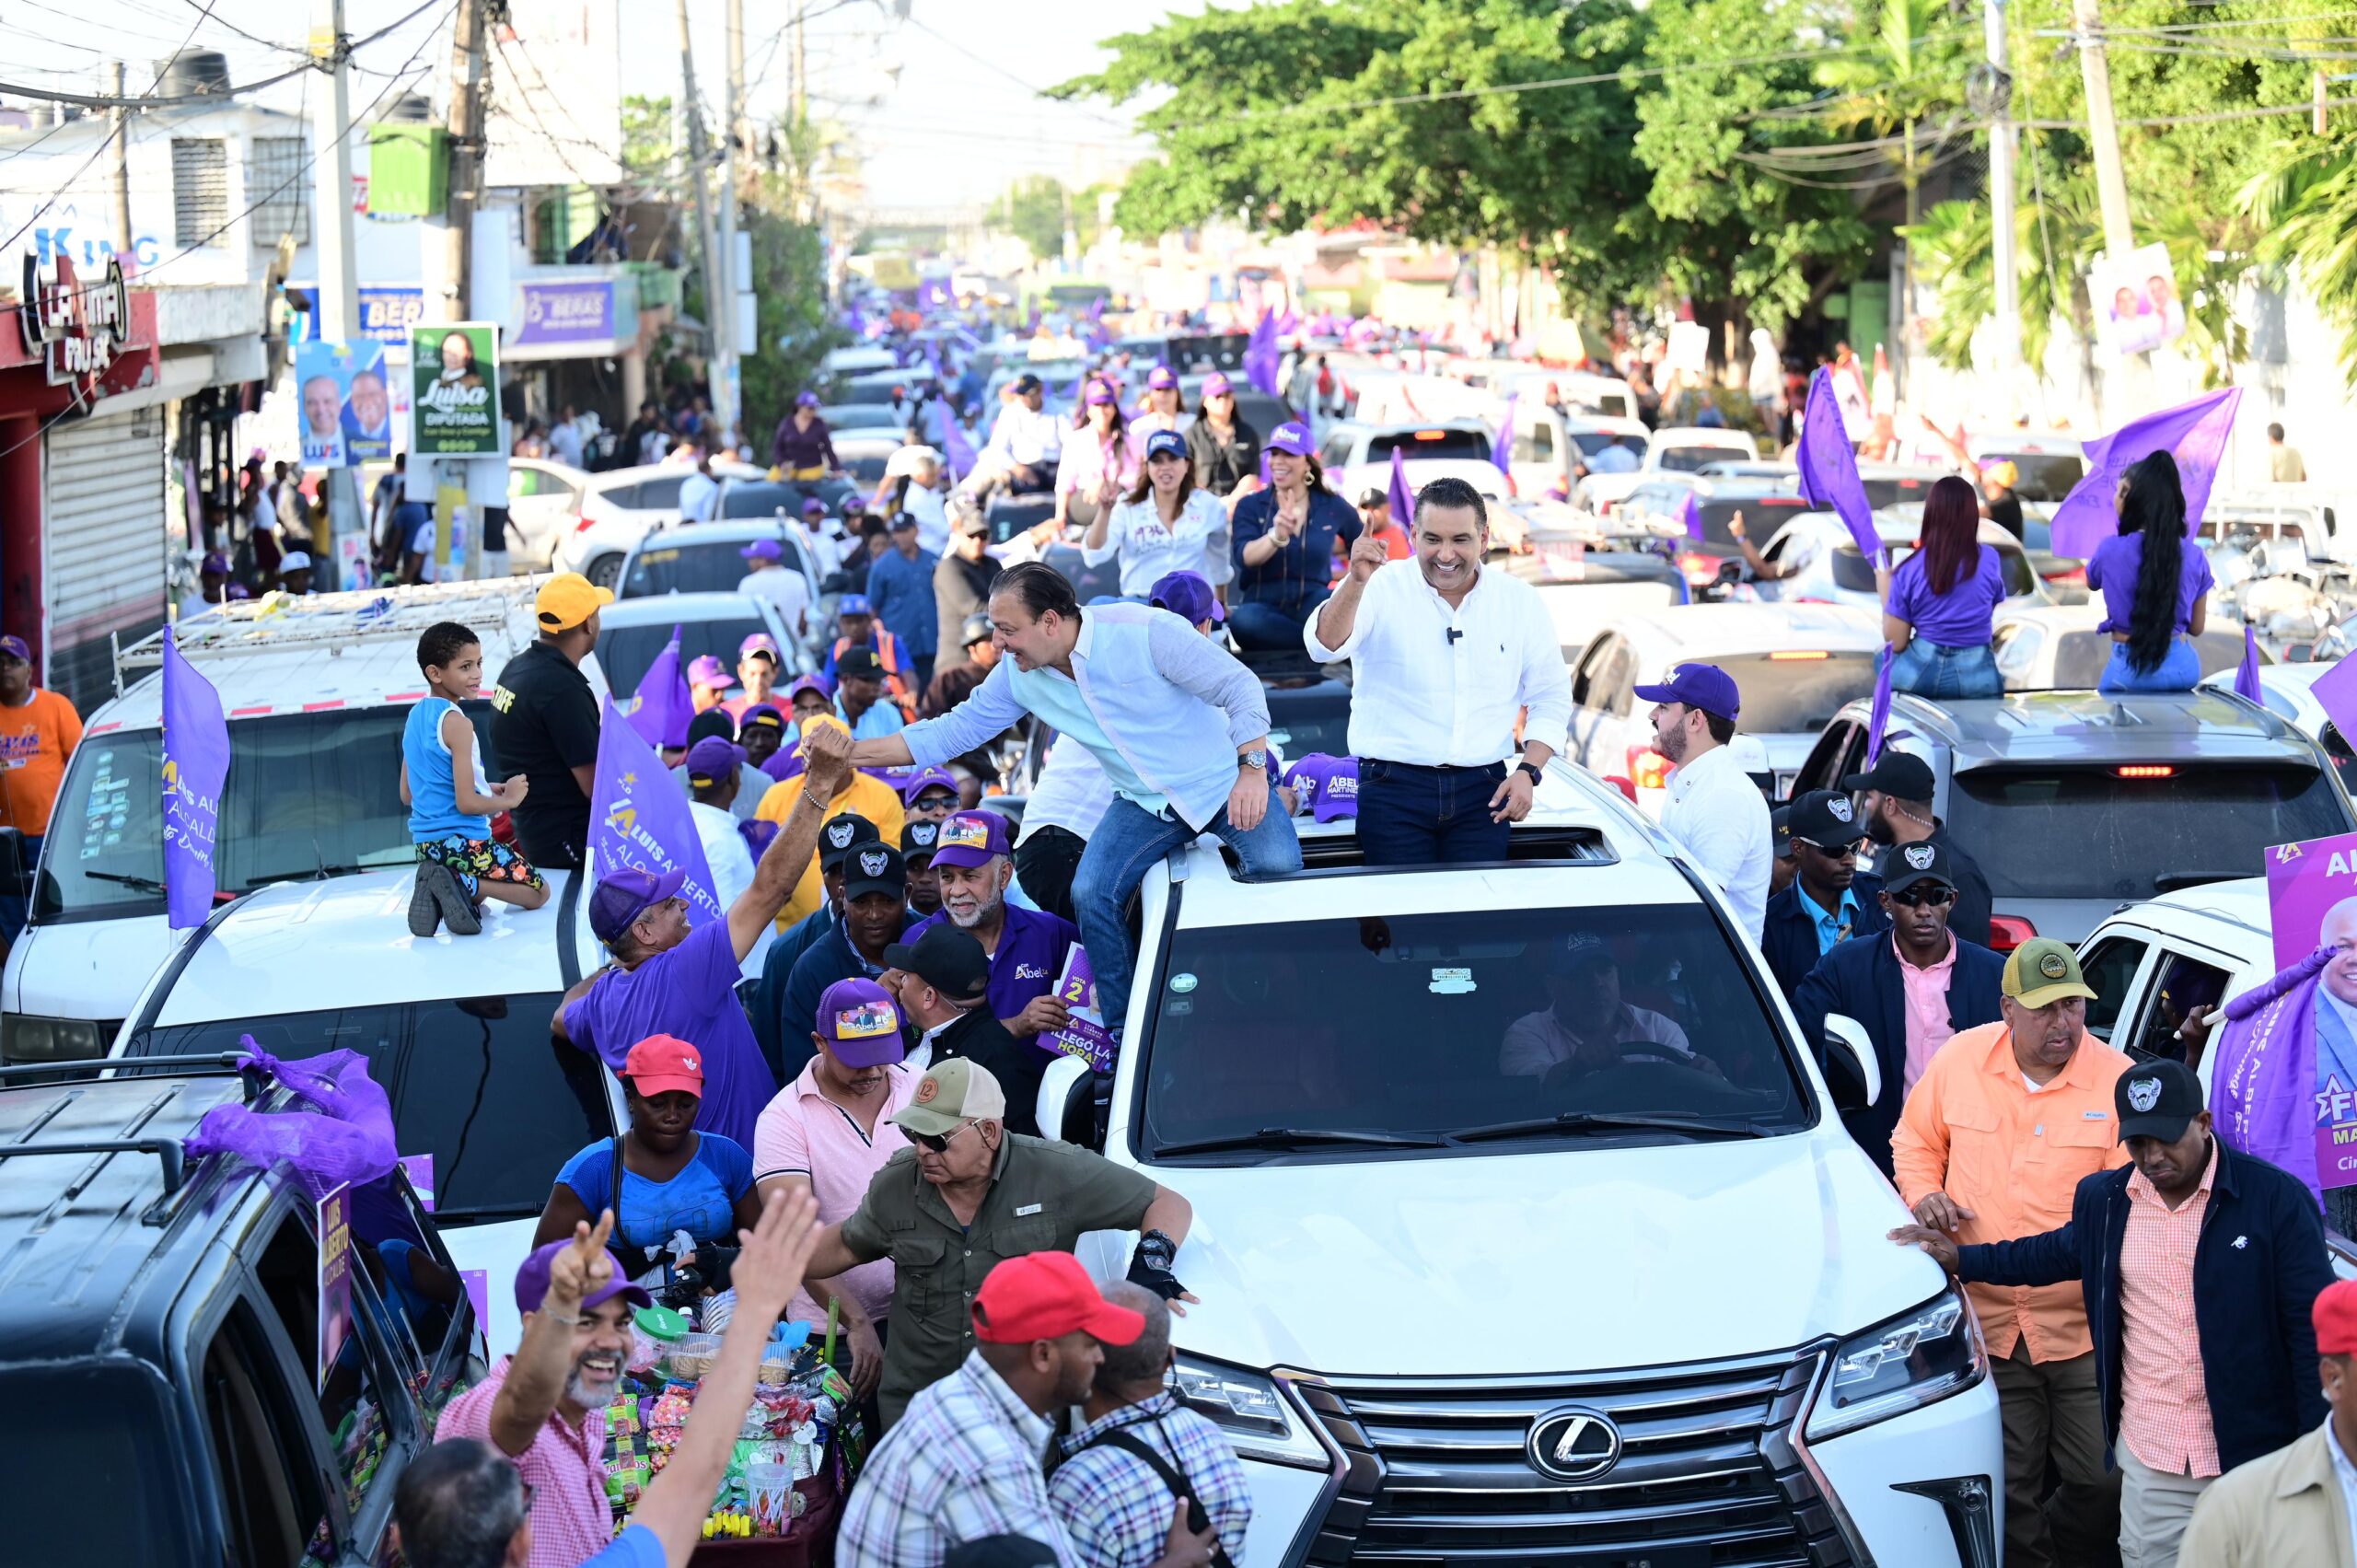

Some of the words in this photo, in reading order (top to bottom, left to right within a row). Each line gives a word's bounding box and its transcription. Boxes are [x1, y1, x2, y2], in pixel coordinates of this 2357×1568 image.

[417, 378, 490, 413] Luisa
[1015, 966, 1044, 980] Abel
[1072, 975, 1086, 985] VOTA
[1064, 981, 1084, 1003] 2
[919, 1083, 934, 1097] 12
